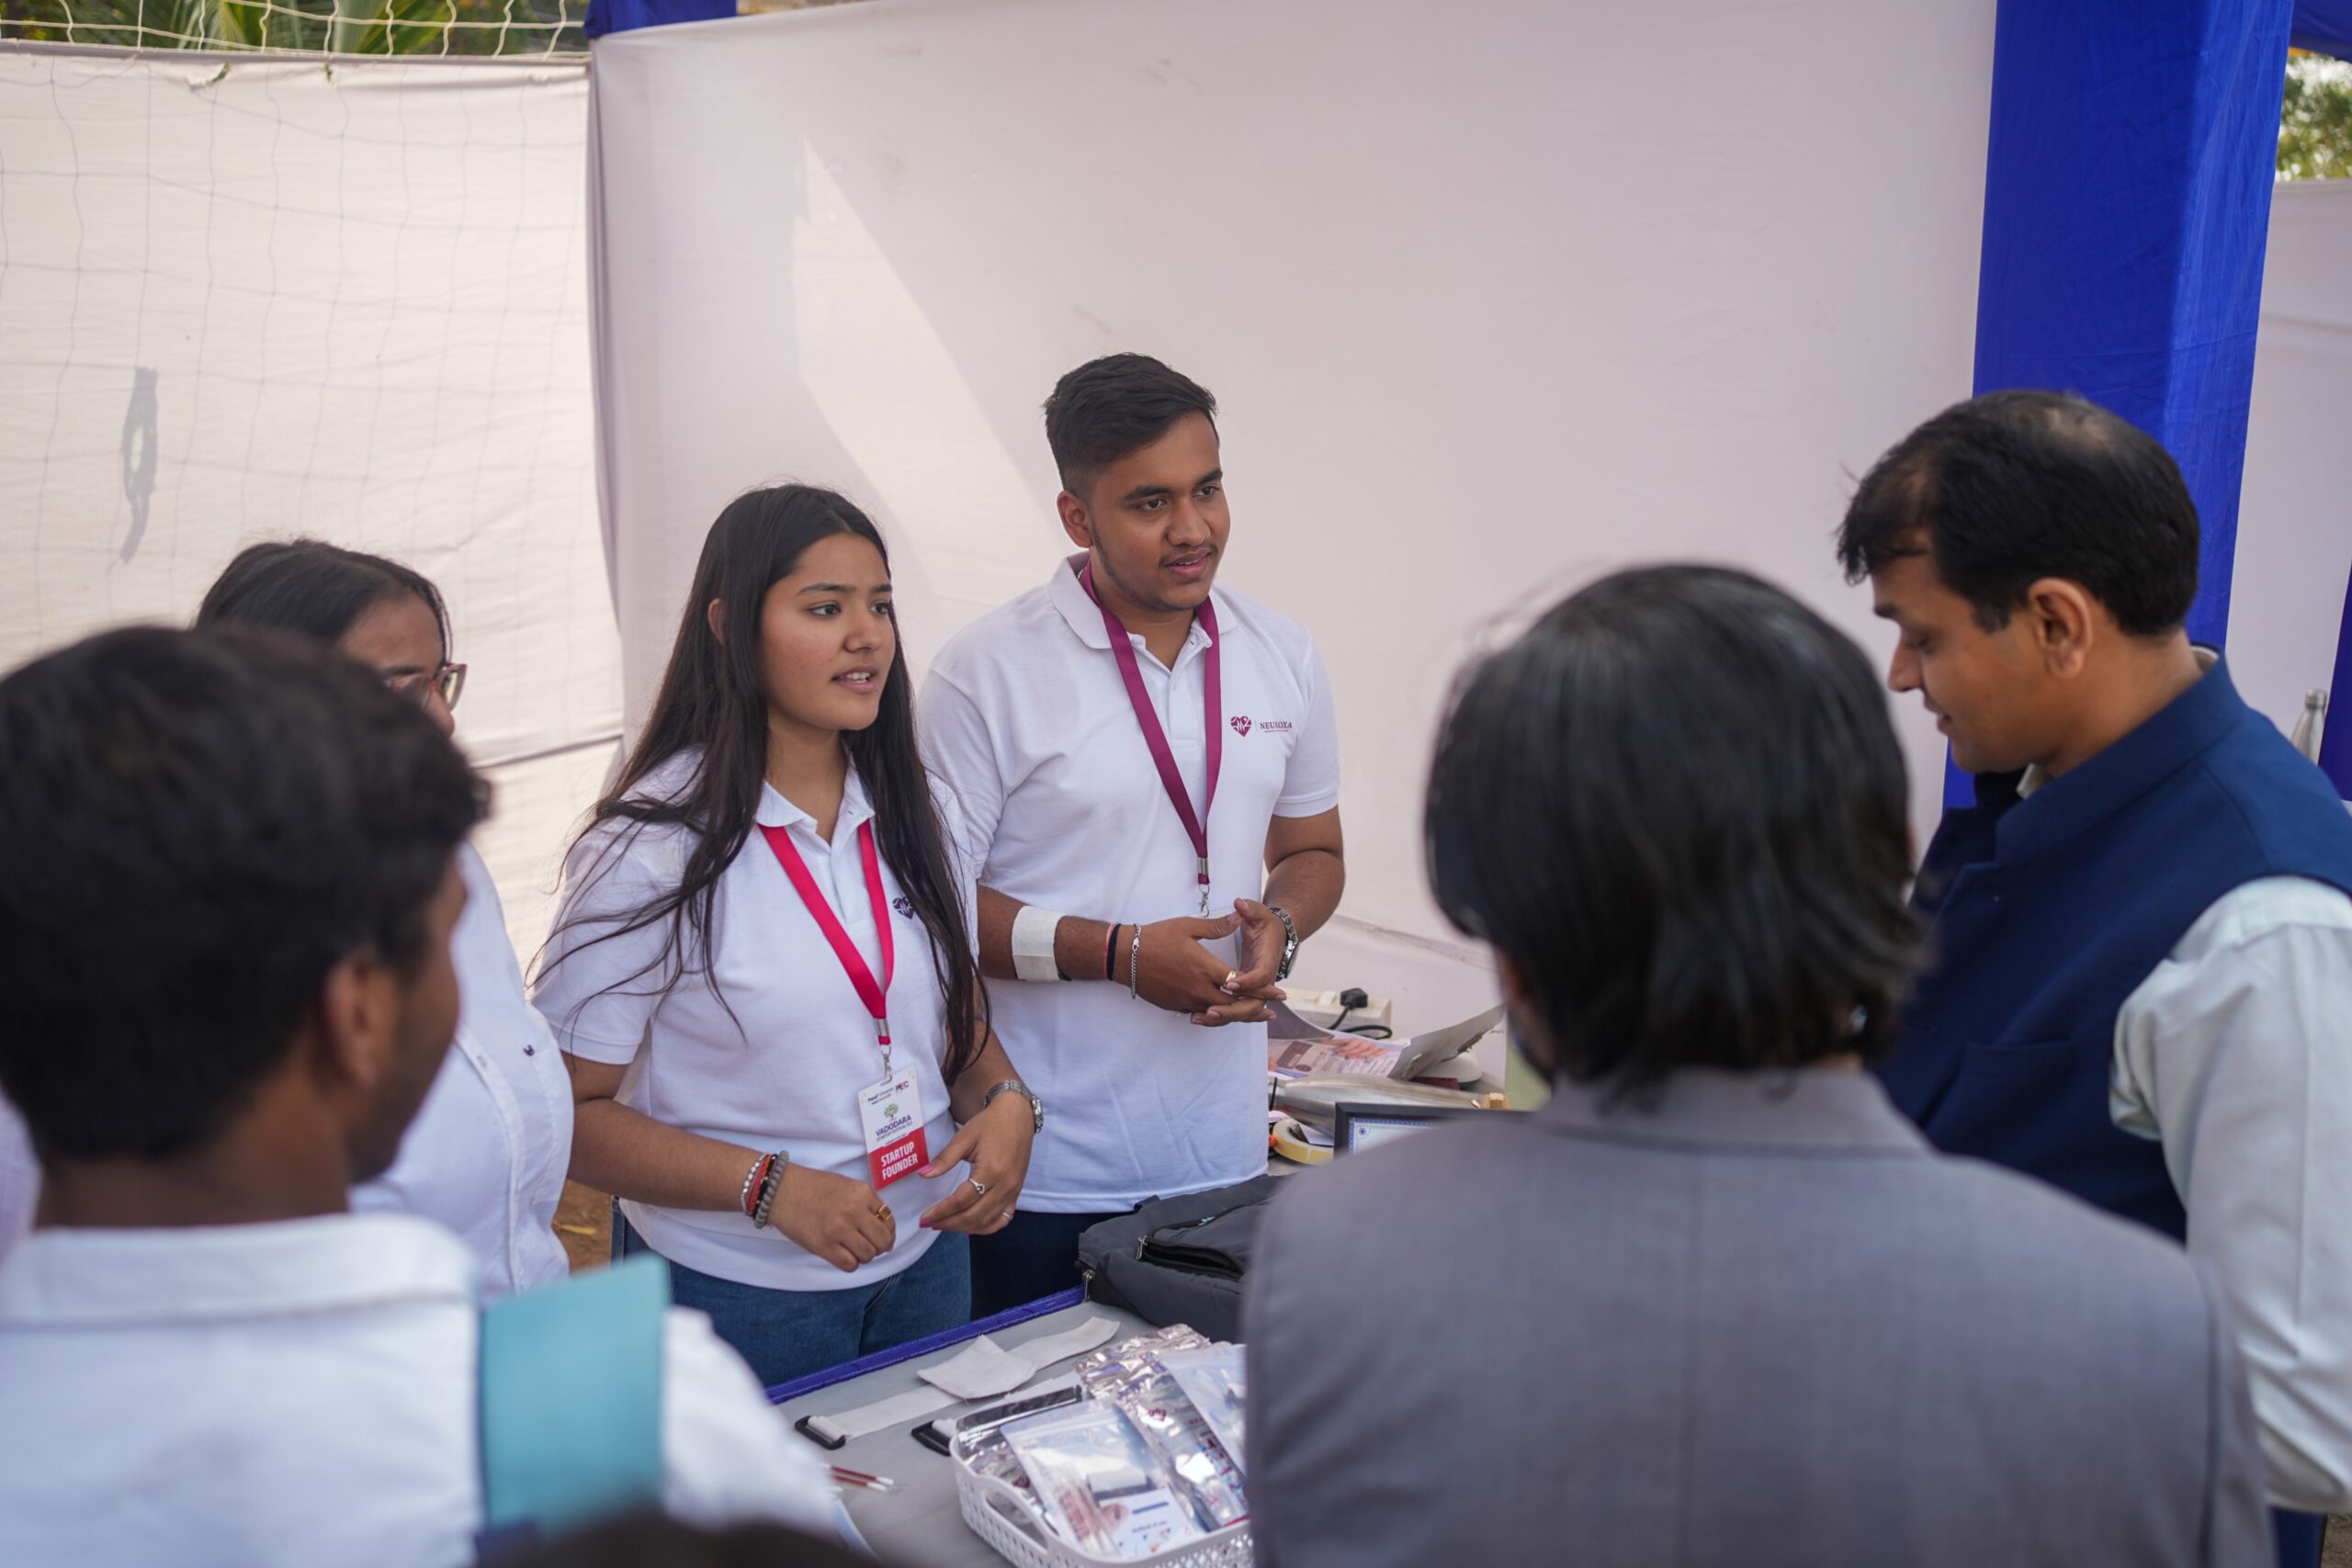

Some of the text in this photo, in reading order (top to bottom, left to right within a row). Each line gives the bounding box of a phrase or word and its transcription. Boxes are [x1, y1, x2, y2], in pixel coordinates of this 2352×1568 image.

[876, 1114, 911, 1136] VADODARA
[881, 1141, 914, 1167] STARTUP
[882, 1153, 919, 1180] FOUNDER
